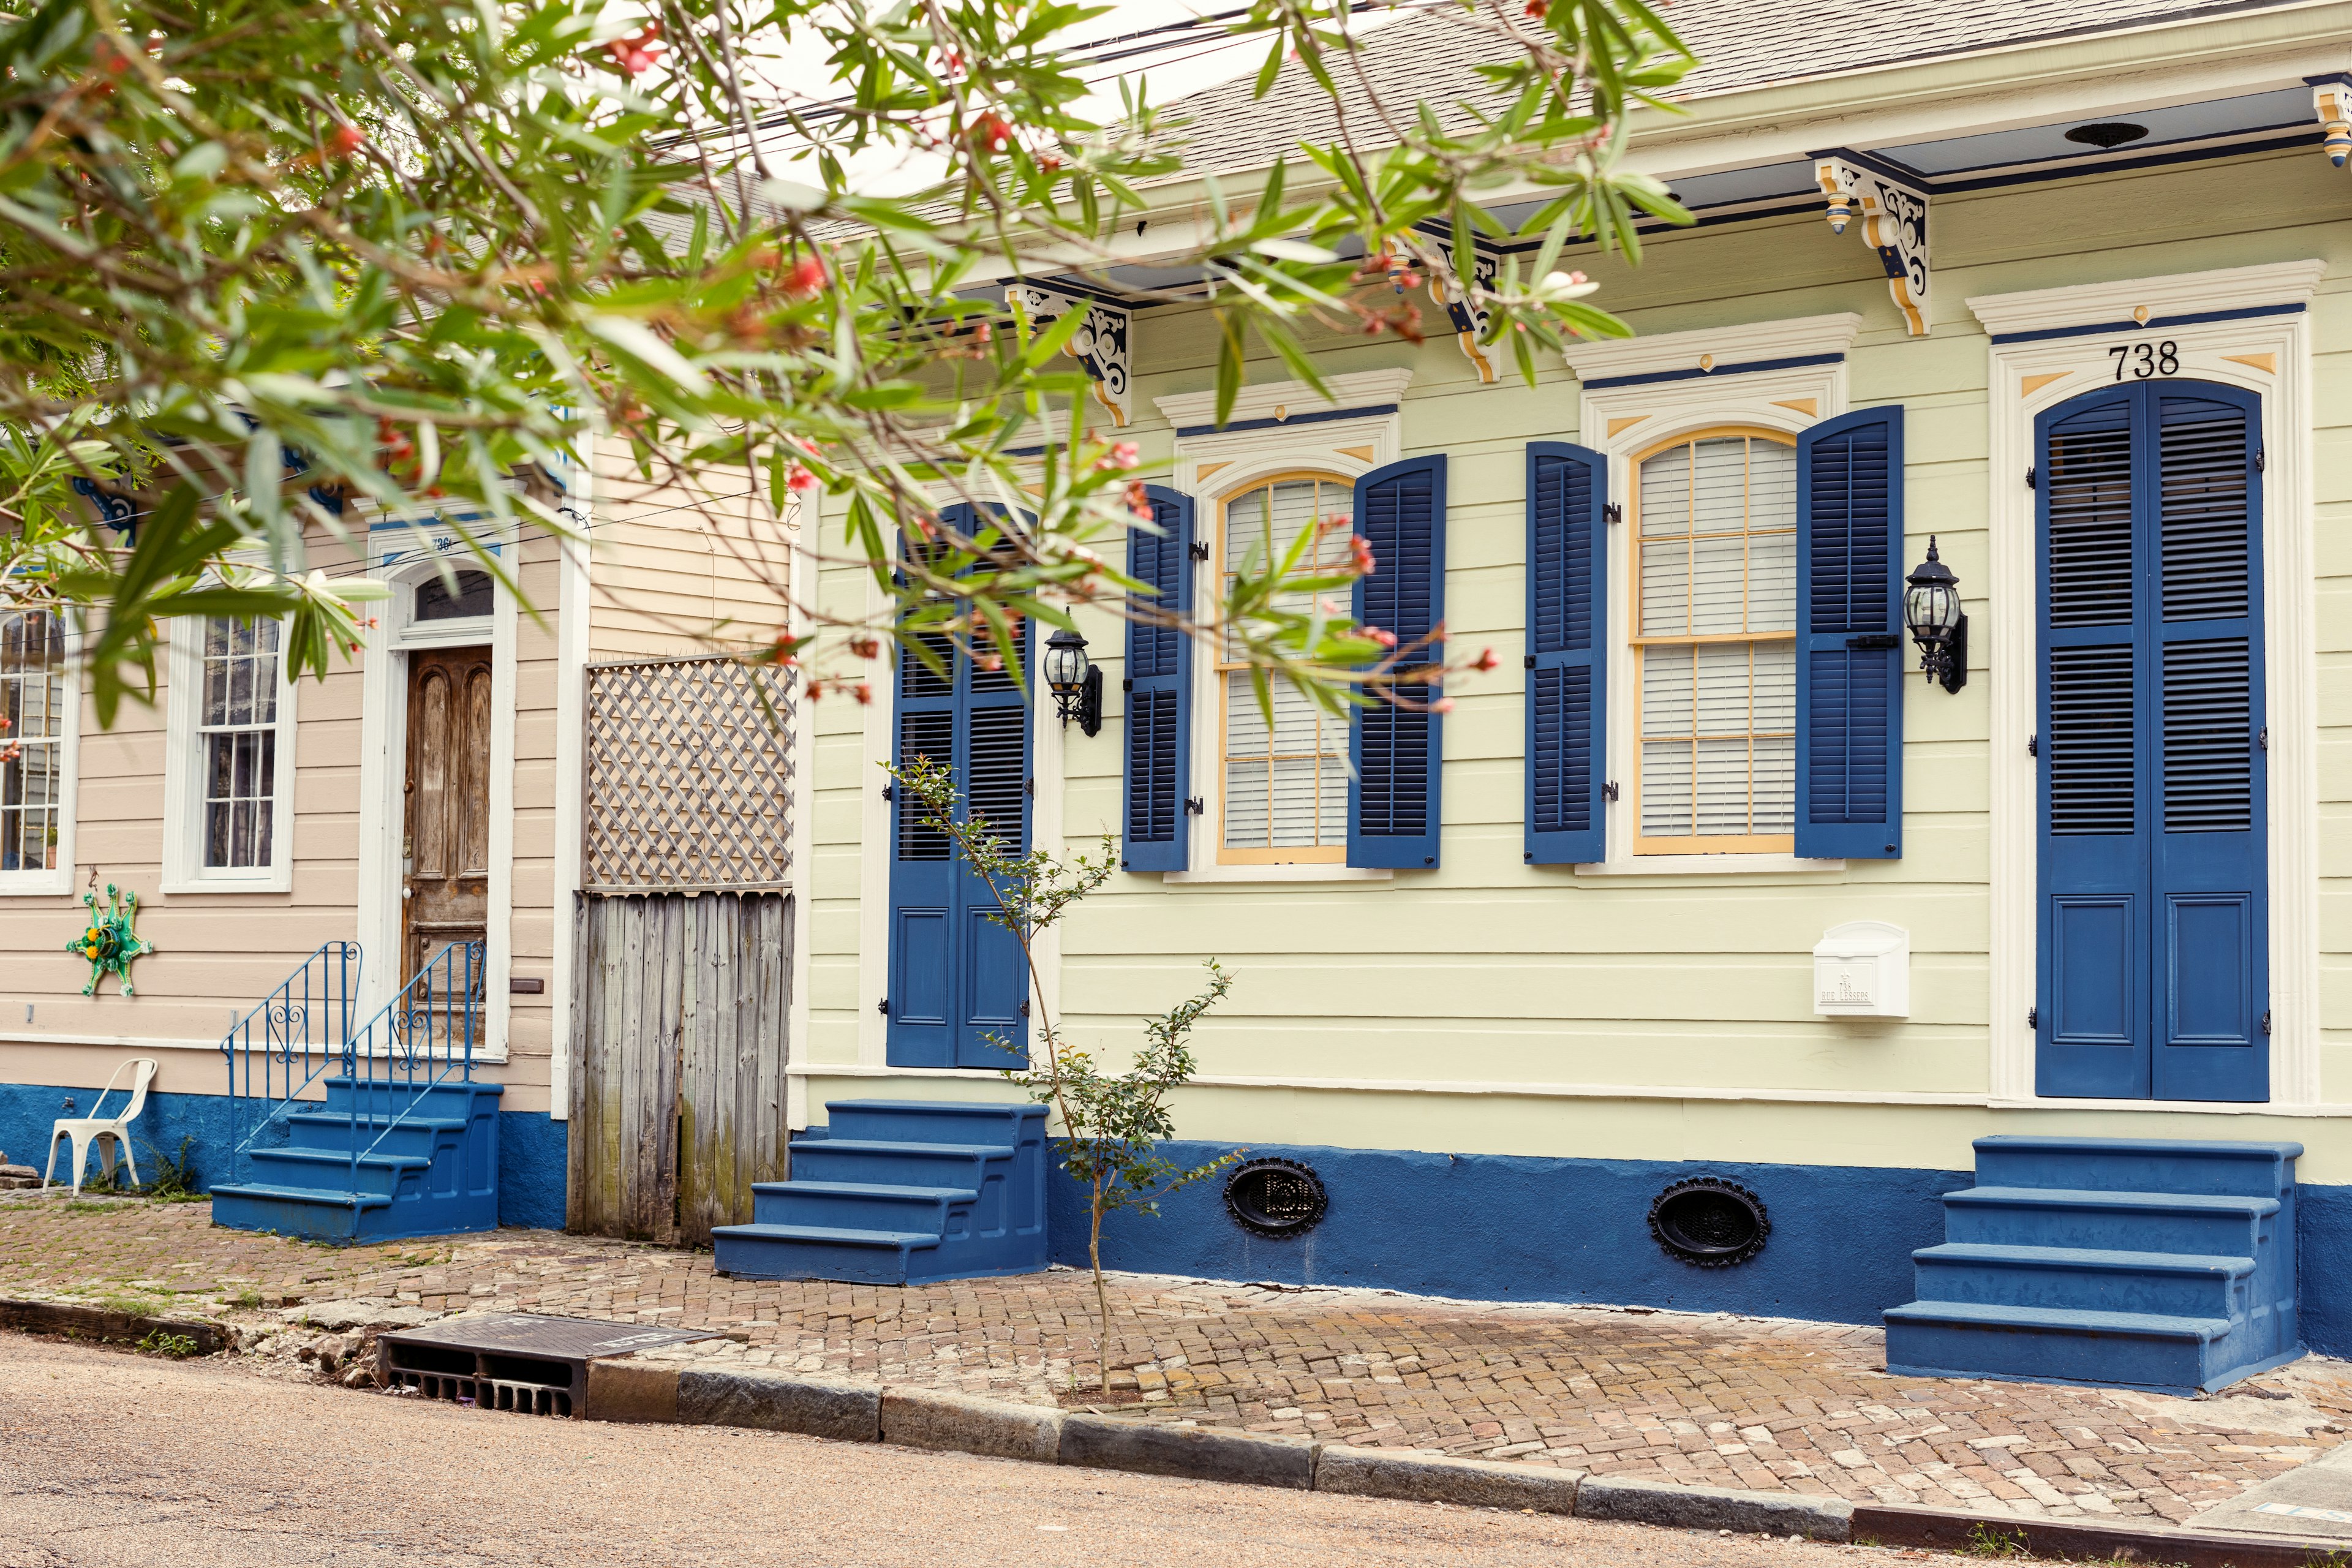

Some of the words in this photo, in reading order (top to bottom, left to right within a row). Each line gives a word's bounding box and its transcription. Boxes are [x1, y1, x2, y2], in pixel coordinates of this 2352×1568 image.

[2109, 341, 2179, 380] 738
[431, 537, 449, 552] 736
[1839, 982, 1852, 991] 738
[1822, 991, 1835, 1000] RUE
[1840, 991, 1868, 1000] LESSEPS
[2255, 1502, 2352, 1521] LES
